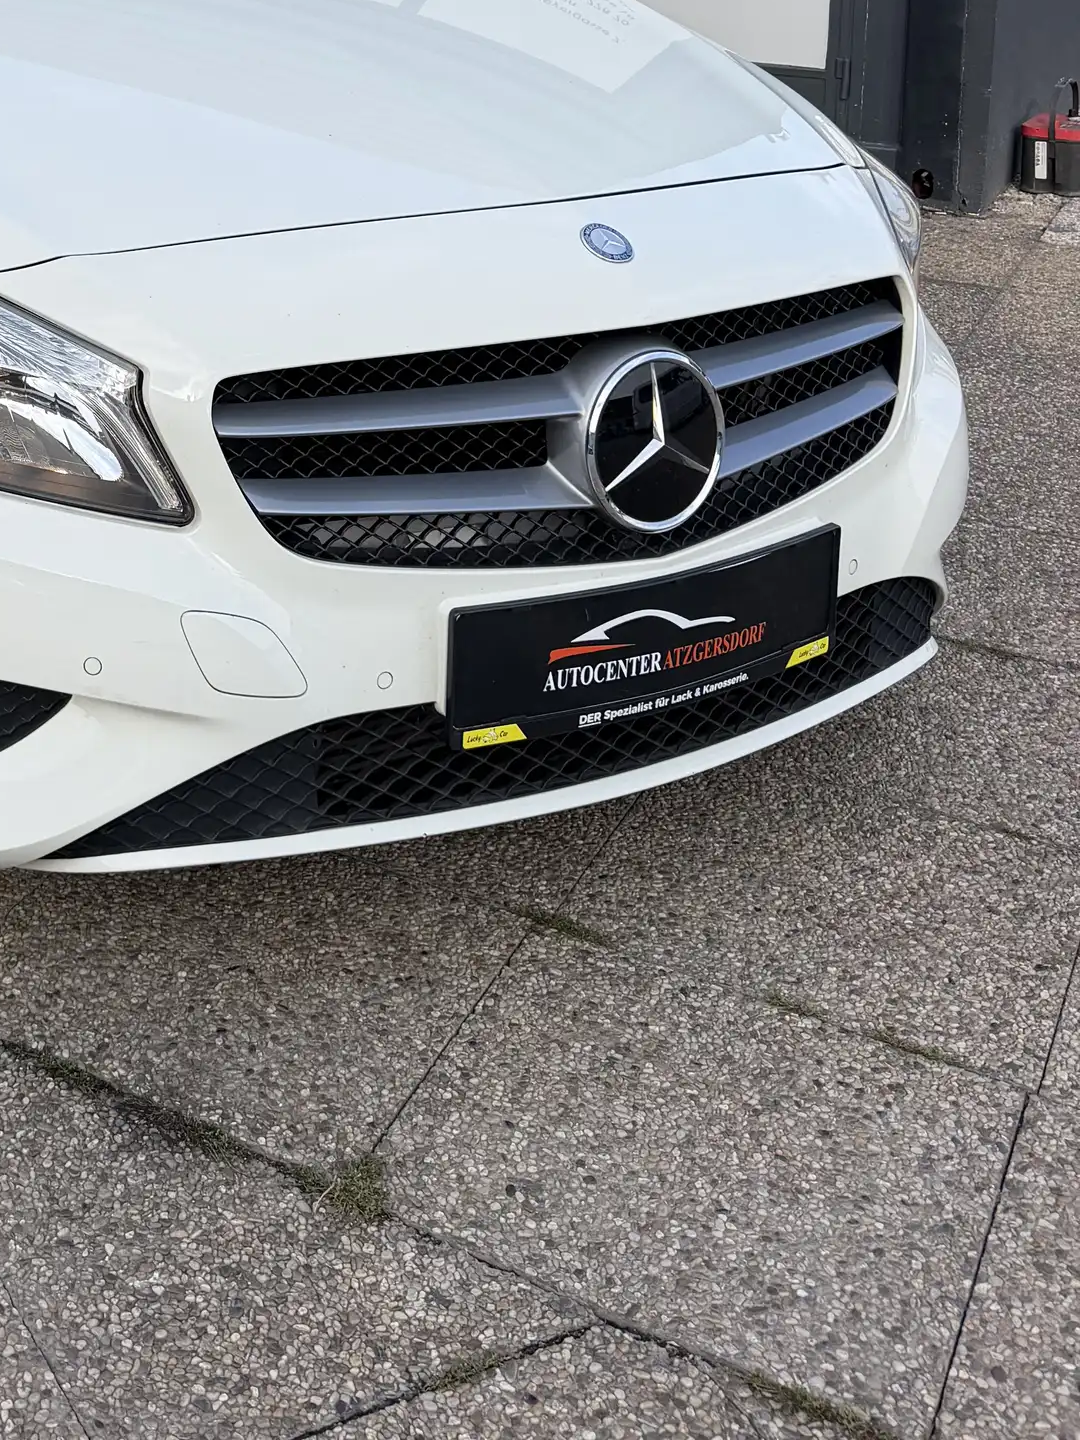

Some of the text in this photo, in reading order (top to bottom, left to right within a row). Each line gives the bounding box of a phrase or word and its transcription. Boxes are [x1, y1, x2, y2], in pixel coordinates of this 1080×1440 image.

[543, 621, 767, 692] AUTOCENTER ATZGERSDORF
[579, 672, 749, 725] DER Spezialist für Lack & Karosserie.
